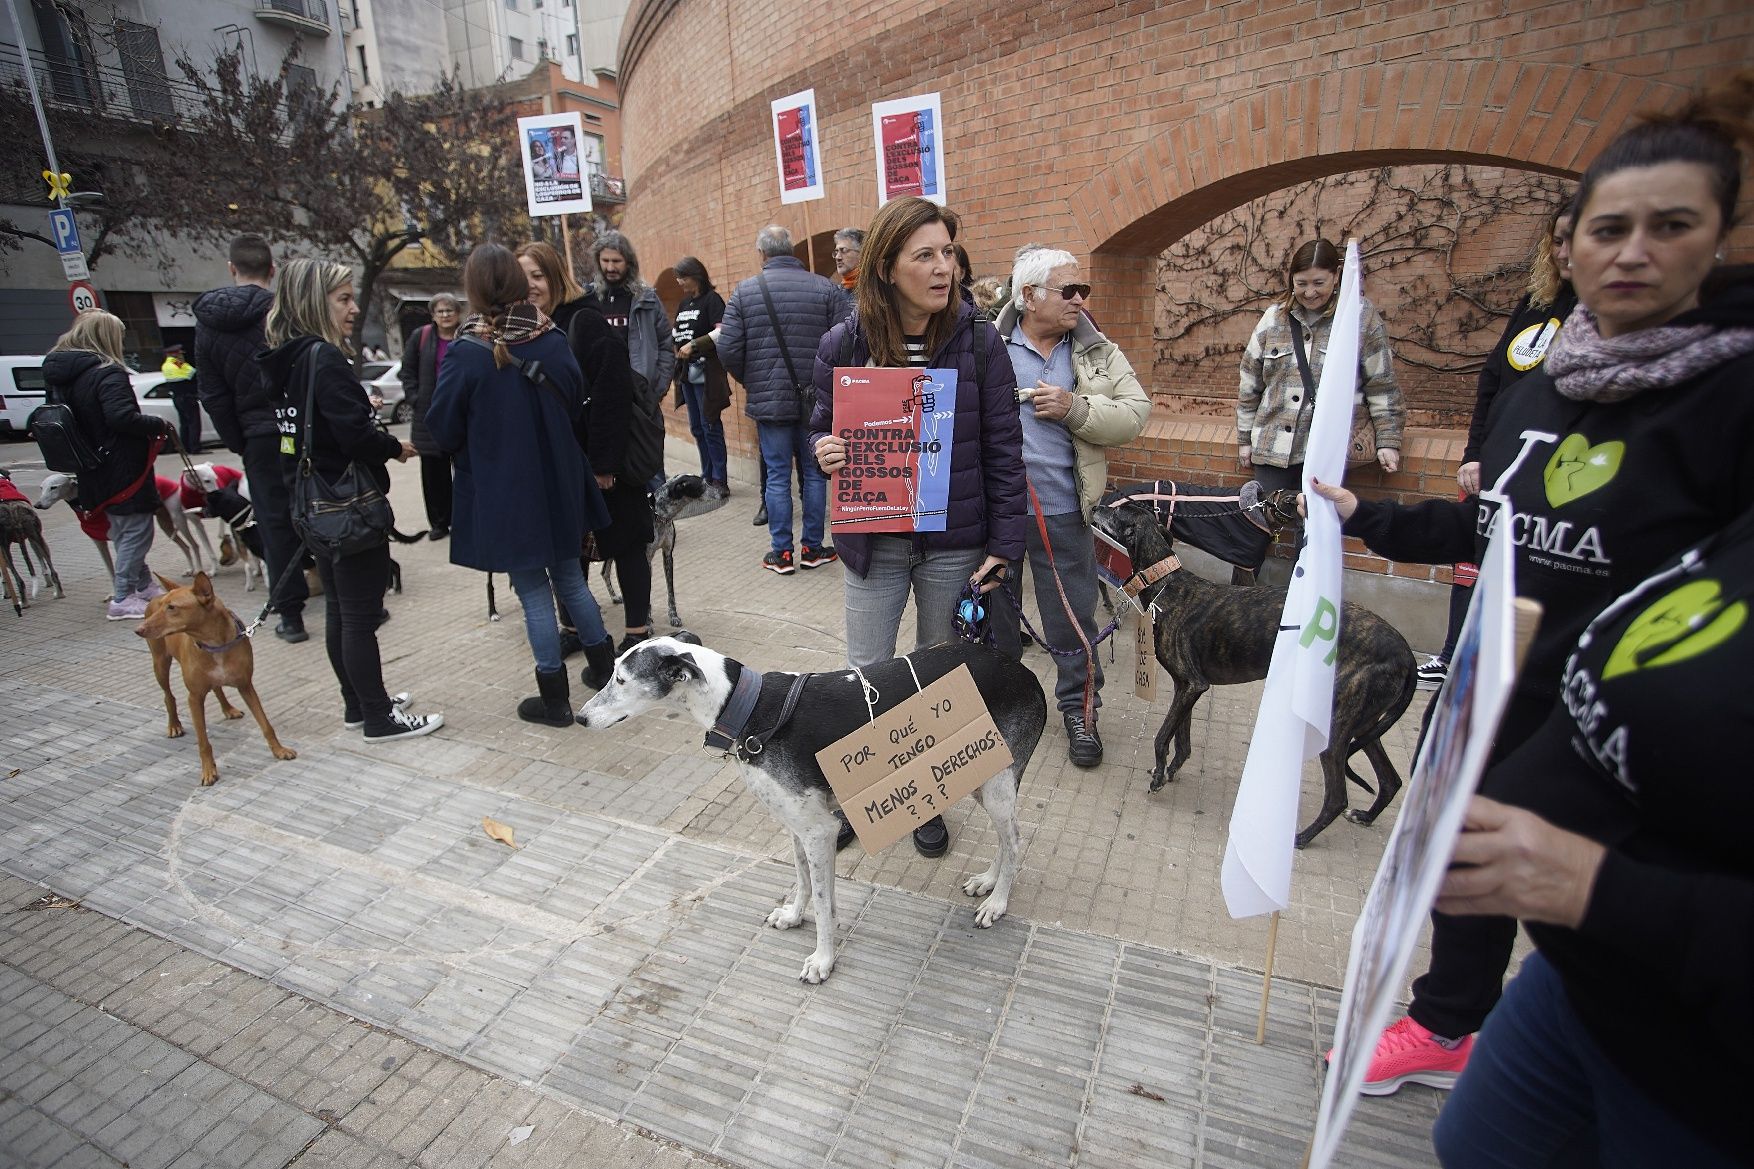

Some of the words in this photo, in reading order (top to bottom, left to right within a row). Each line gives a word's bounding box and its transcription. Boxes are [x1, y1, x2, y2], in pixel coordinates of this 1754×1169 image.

[886, 142, 918, 151] CONTRA
[887, 157, 907, 165] DELS
[887, 162, 919, 171] GOSSOS
[54, 214, 71, 249] P
[75, 296, 93, 310] 30
[863, 419, 893, 428] Podemos
[839, 428, 916, 441] CONTRA
[838, 466, 913, 479] GOSSOS
[838, 479, 863, 491] DE
[837, 491, 888, 506] CAÇA
[1528, 554, 1610, 577] www.pacma.es
[840, 745, 876, 772] POR
[889, 715, 918, 745] QUÉ
[930, 699, 952, 718] YO
[887, 735, 936, 770] TENGO
[864, 780, 918, 824] MENOS
